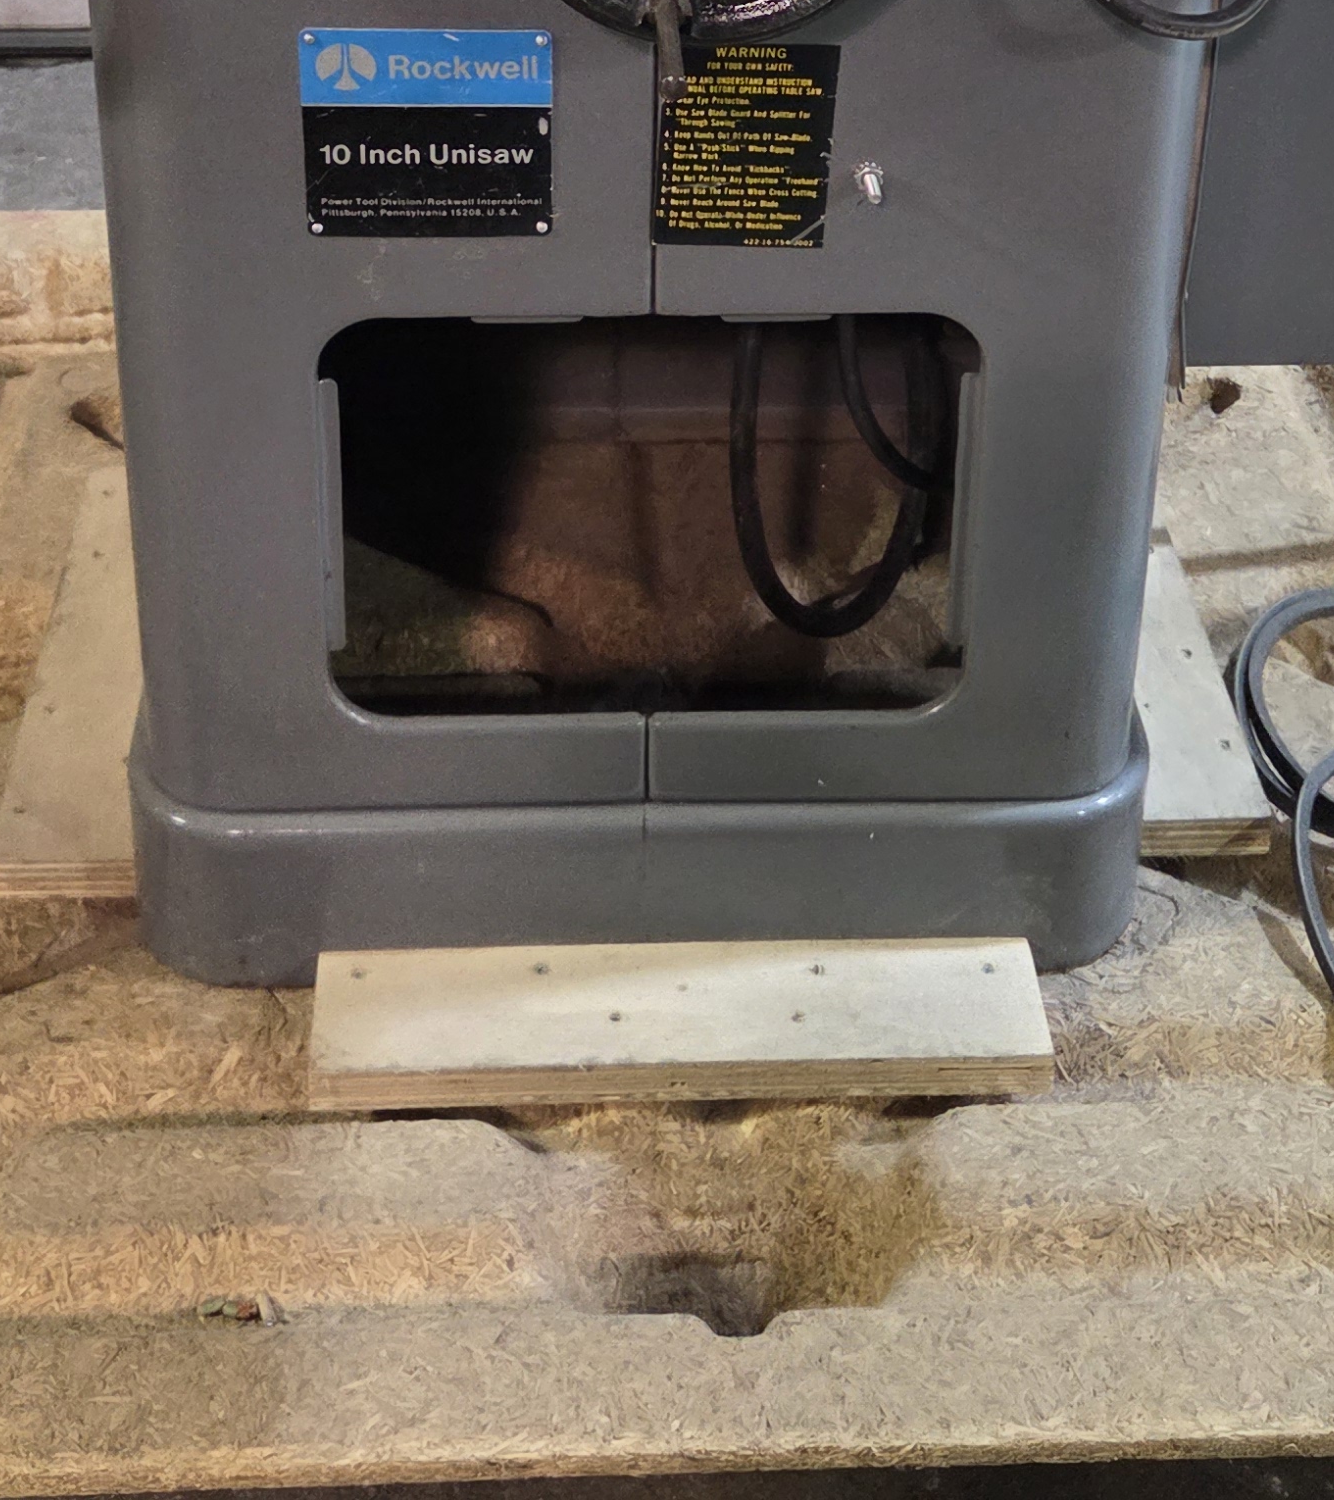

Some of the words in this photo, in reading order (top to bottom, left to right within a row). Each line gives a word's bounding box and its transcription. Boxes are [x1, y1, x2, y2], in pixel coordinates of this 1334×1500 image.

[716, 47, 787, 59] WARNING
[389, 55, 538, 80] Rockwell
[319, 144, 351, 164] 10
[360, 144, 420, 164] Inch
[430, 144, 533, 164] Unisaw
